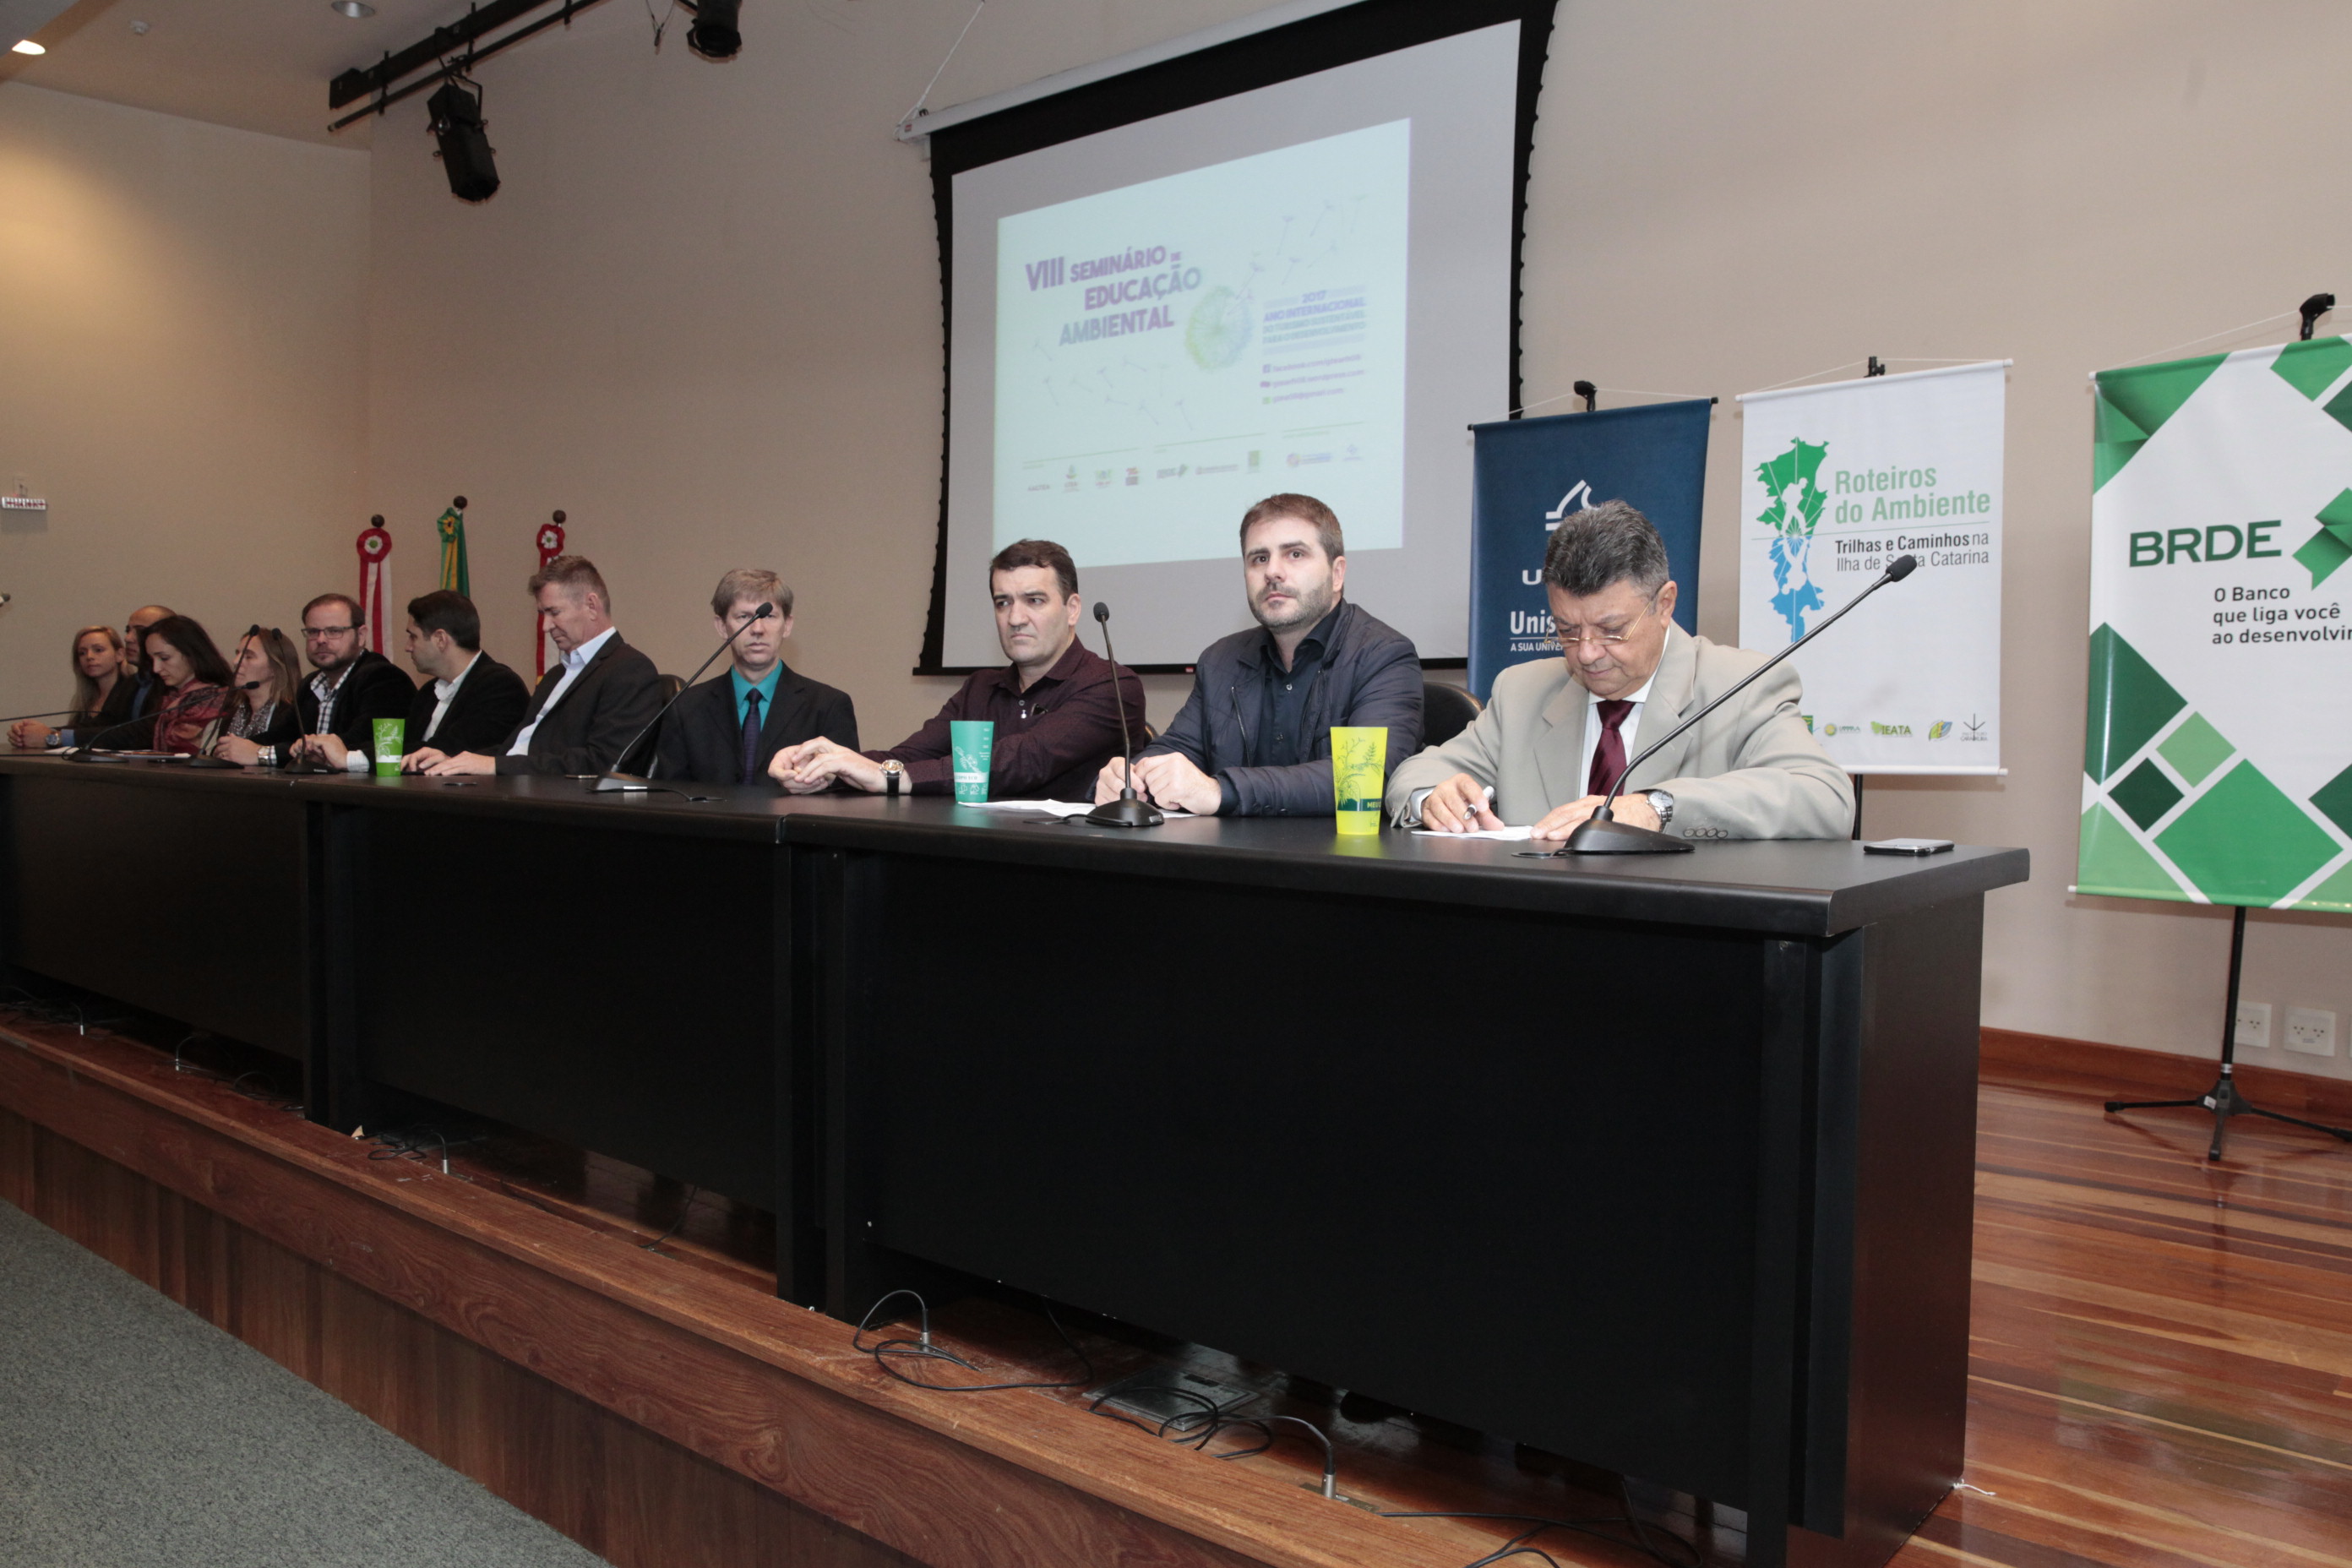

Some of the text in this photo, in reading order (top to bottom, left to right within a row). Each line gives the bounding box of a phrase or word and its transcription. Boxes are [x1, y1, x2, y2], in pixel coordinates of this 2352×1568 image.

[1025, 256, 1064, 291] VIII
[1070, 245, 1166, 283] SEMINÁRIO
[1084, 263, 1202, 311] EDUCAÇÃO
[1301, 290, 1327, 303] 2017
[1264, 297, 1366, 323] ANO INTERNACIONAL
[1059, 304, 1175, 346] AMBIENTAL
[1835, 466, 1937, 495] Roteiros
[1834, 490, 1990, 524] do Ambiente
[1835, 532, 1990, 554] Trilhas e Caminhos na
[2129, 520, 2282, 568] BRDE
[1837, 551, 1990, 572] Ilha de Sta Catarina
[2214, 586, 2290, 602] O Banco
[1511, 609, 1556, 634] Unis
[2213, 602, 2341, 627] que liga você
[1511, 643, 1516, 651] A
[1517, 642, 1534, 651] SUA
[2212, 631, 2233, 645] ao
[1881, 725, 1912, 735] IEATA
